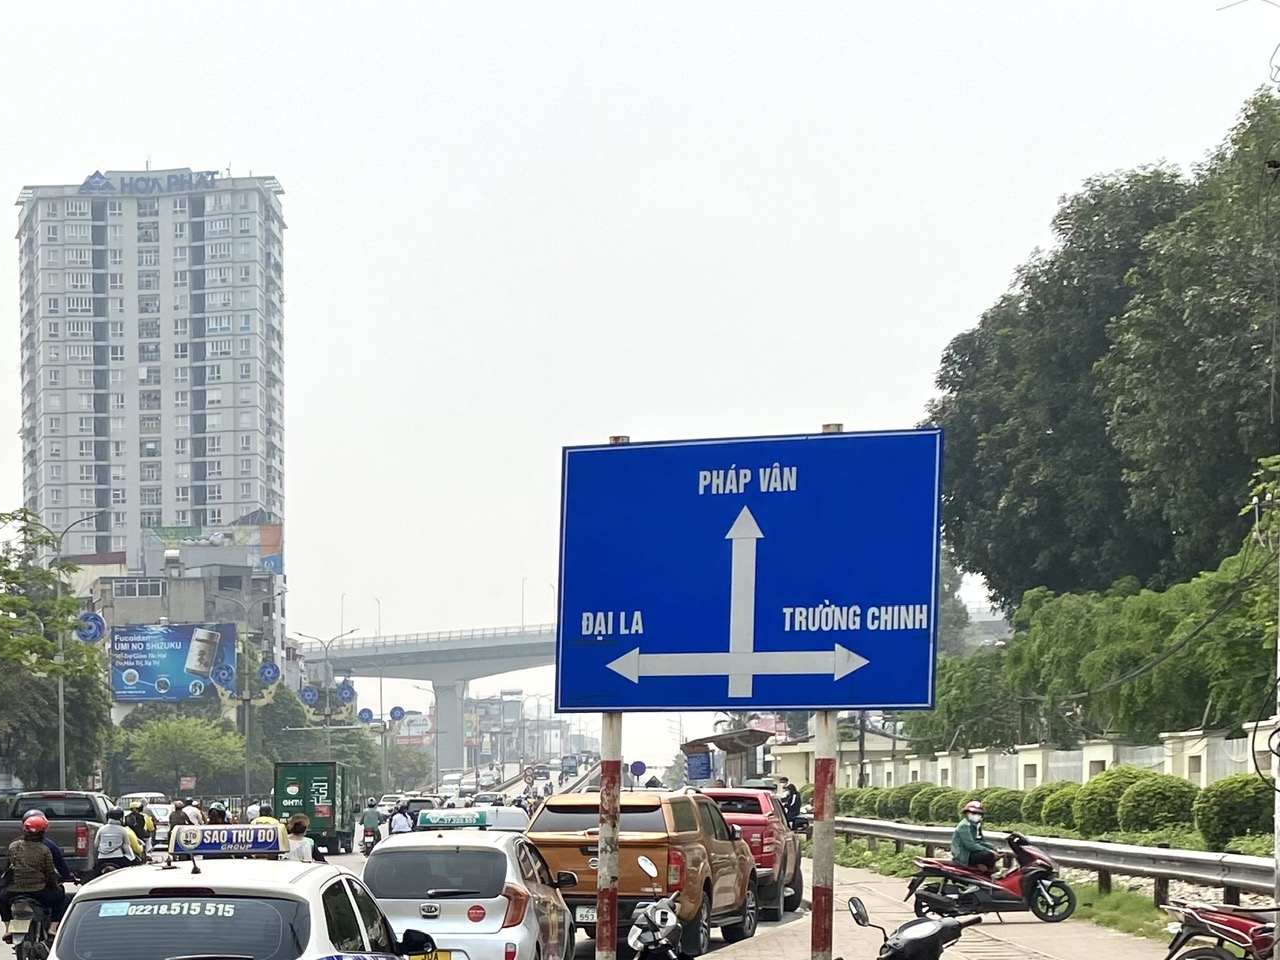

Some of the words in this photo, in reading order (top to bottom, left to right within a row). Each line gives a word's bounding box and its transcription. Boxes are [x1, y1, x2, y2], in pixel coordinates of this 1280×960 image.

[699, 464, 751, 495] PHÁP
[759, 462, 797, 492] VÂN
[783, 600, 860, 632] TRƯỜNG
[867, 605, 928, 631] CHINH
[582, 612, 613, 641] ĐẠI
[620, 611, 644, 635] LA
[114, 634, 151, 642] Fucoidan
[114, 643, 130, 651] UMI
[145, 642, 182, 650] SHIZUKU
[203, 830, 228, 844] SAO
[220, 843, 252, 851] GROUP
[204, 902, 235, 917] 515
